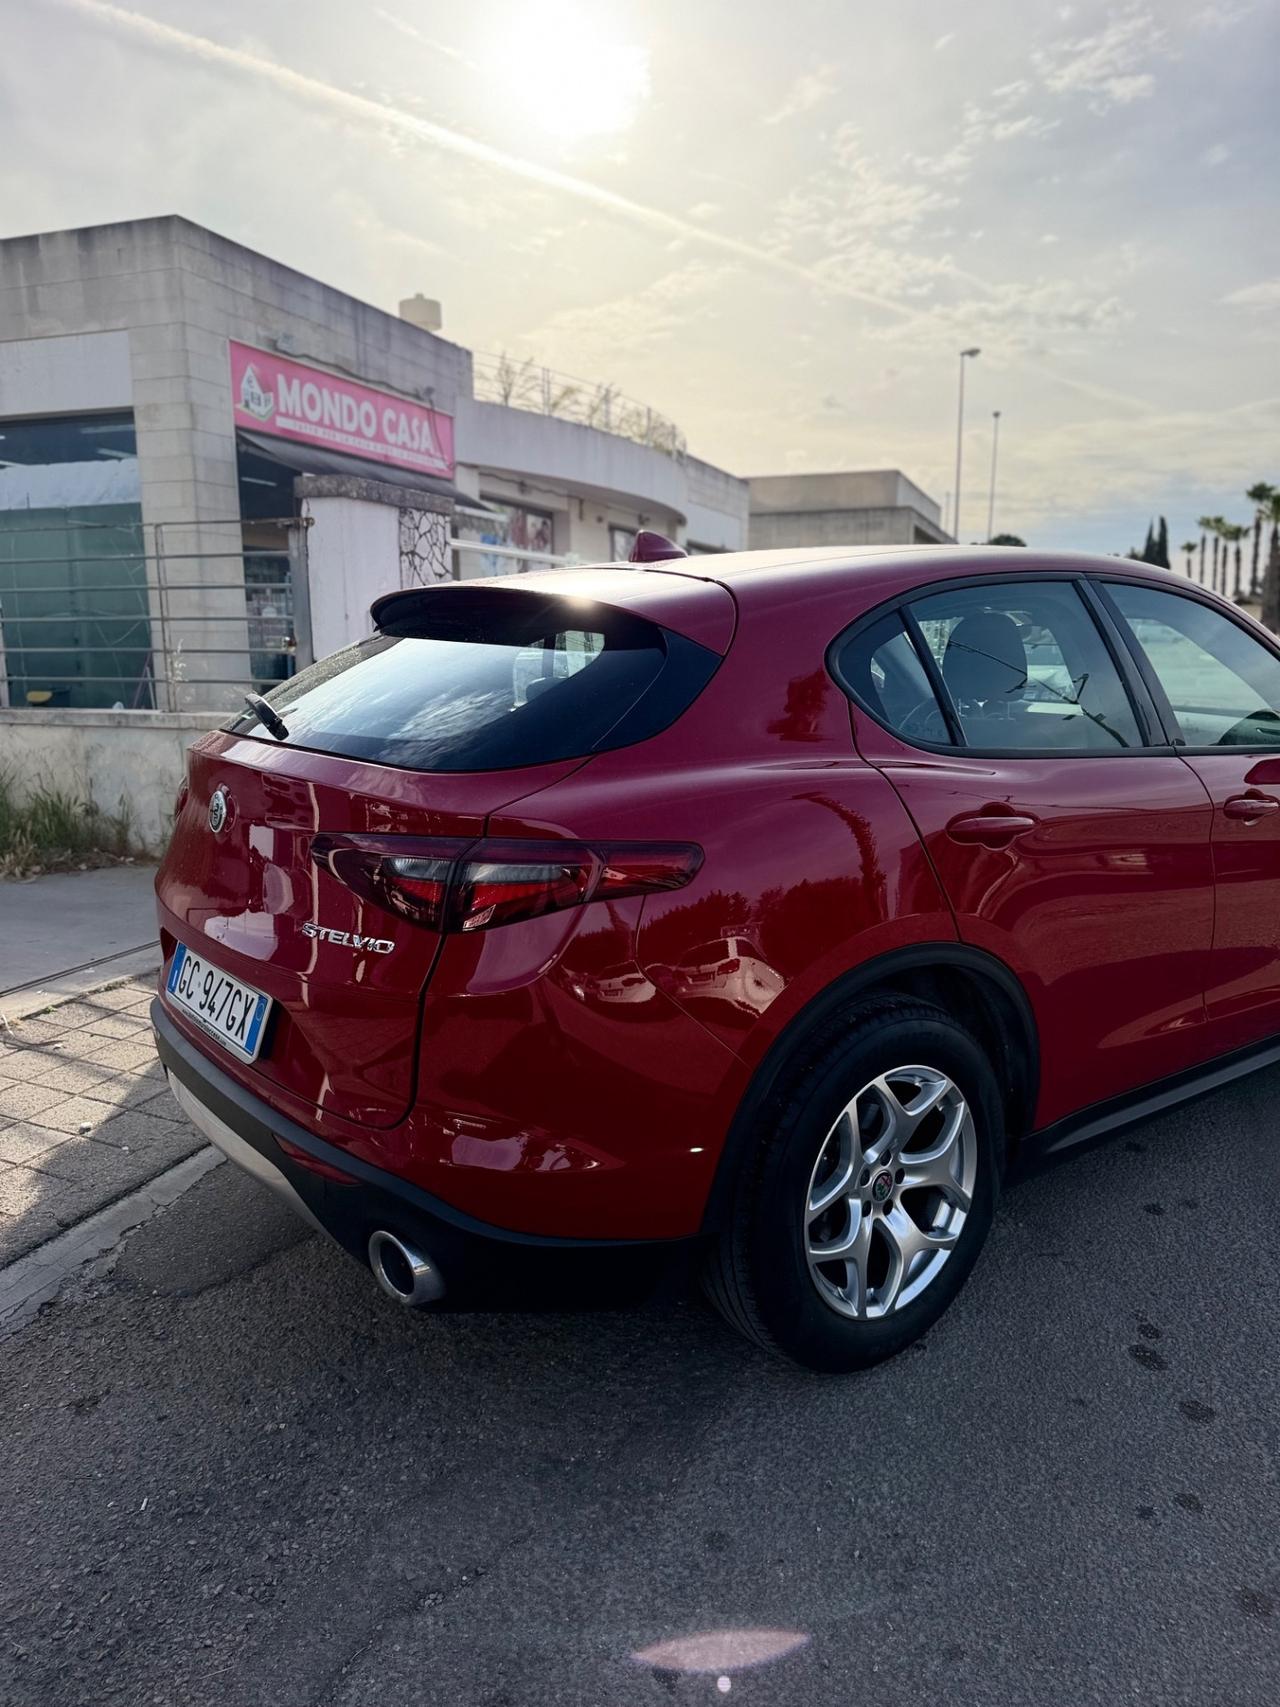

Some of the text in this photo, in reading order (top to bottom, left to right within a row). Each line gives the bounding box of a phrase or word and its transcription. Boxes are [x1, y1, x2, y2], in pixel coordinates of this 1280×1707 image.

[277, 373, 434, 452] MONDO CASA
[302, 922, 395, 954] STELVIO
[178, 955, 200, 999] GC
[199, 970, 255, 1041] 947GX
